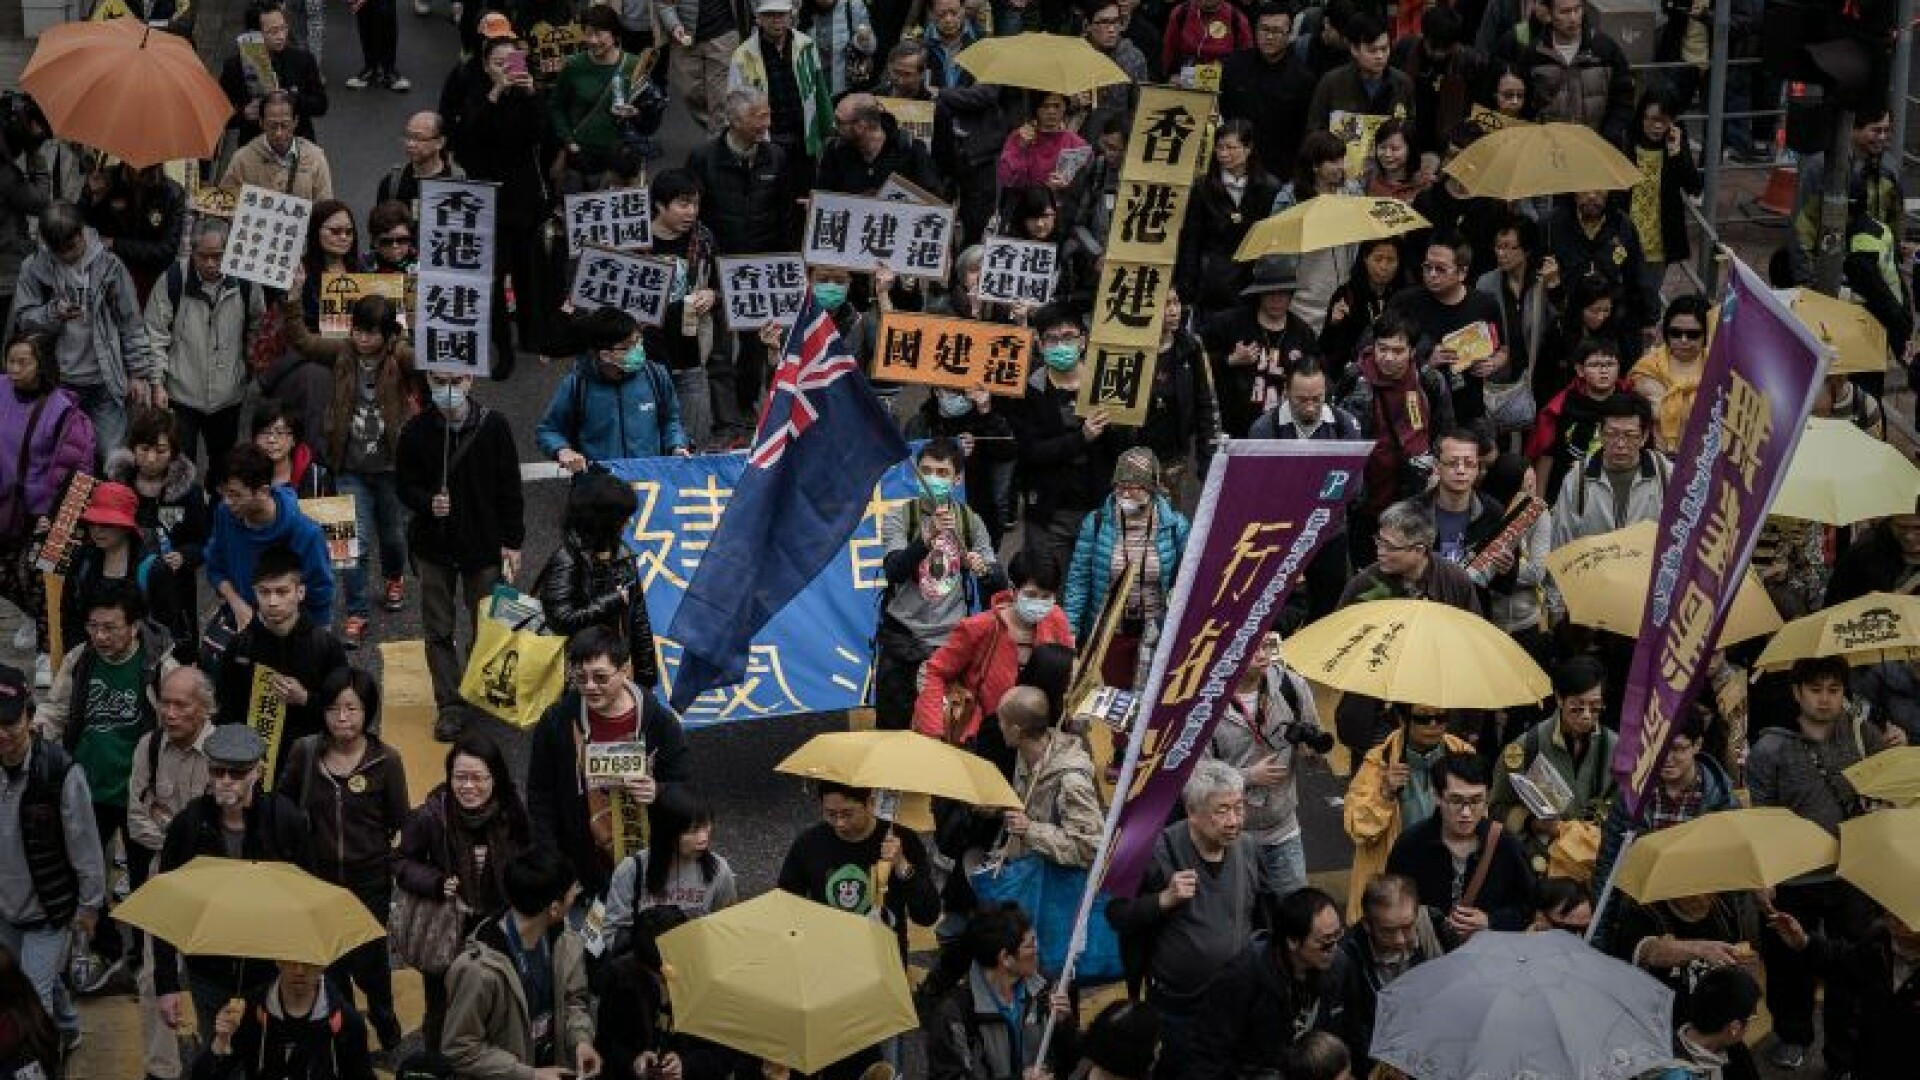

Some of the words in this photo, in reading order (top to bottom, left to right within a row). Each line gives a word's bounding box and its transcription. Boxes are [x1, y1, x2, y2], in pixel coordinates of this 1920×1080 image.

[426, 190, 485, 365] 香港建國
[1089, 105, 1196, 409] 香港建國
[590, 756, 642, 774] D7689
